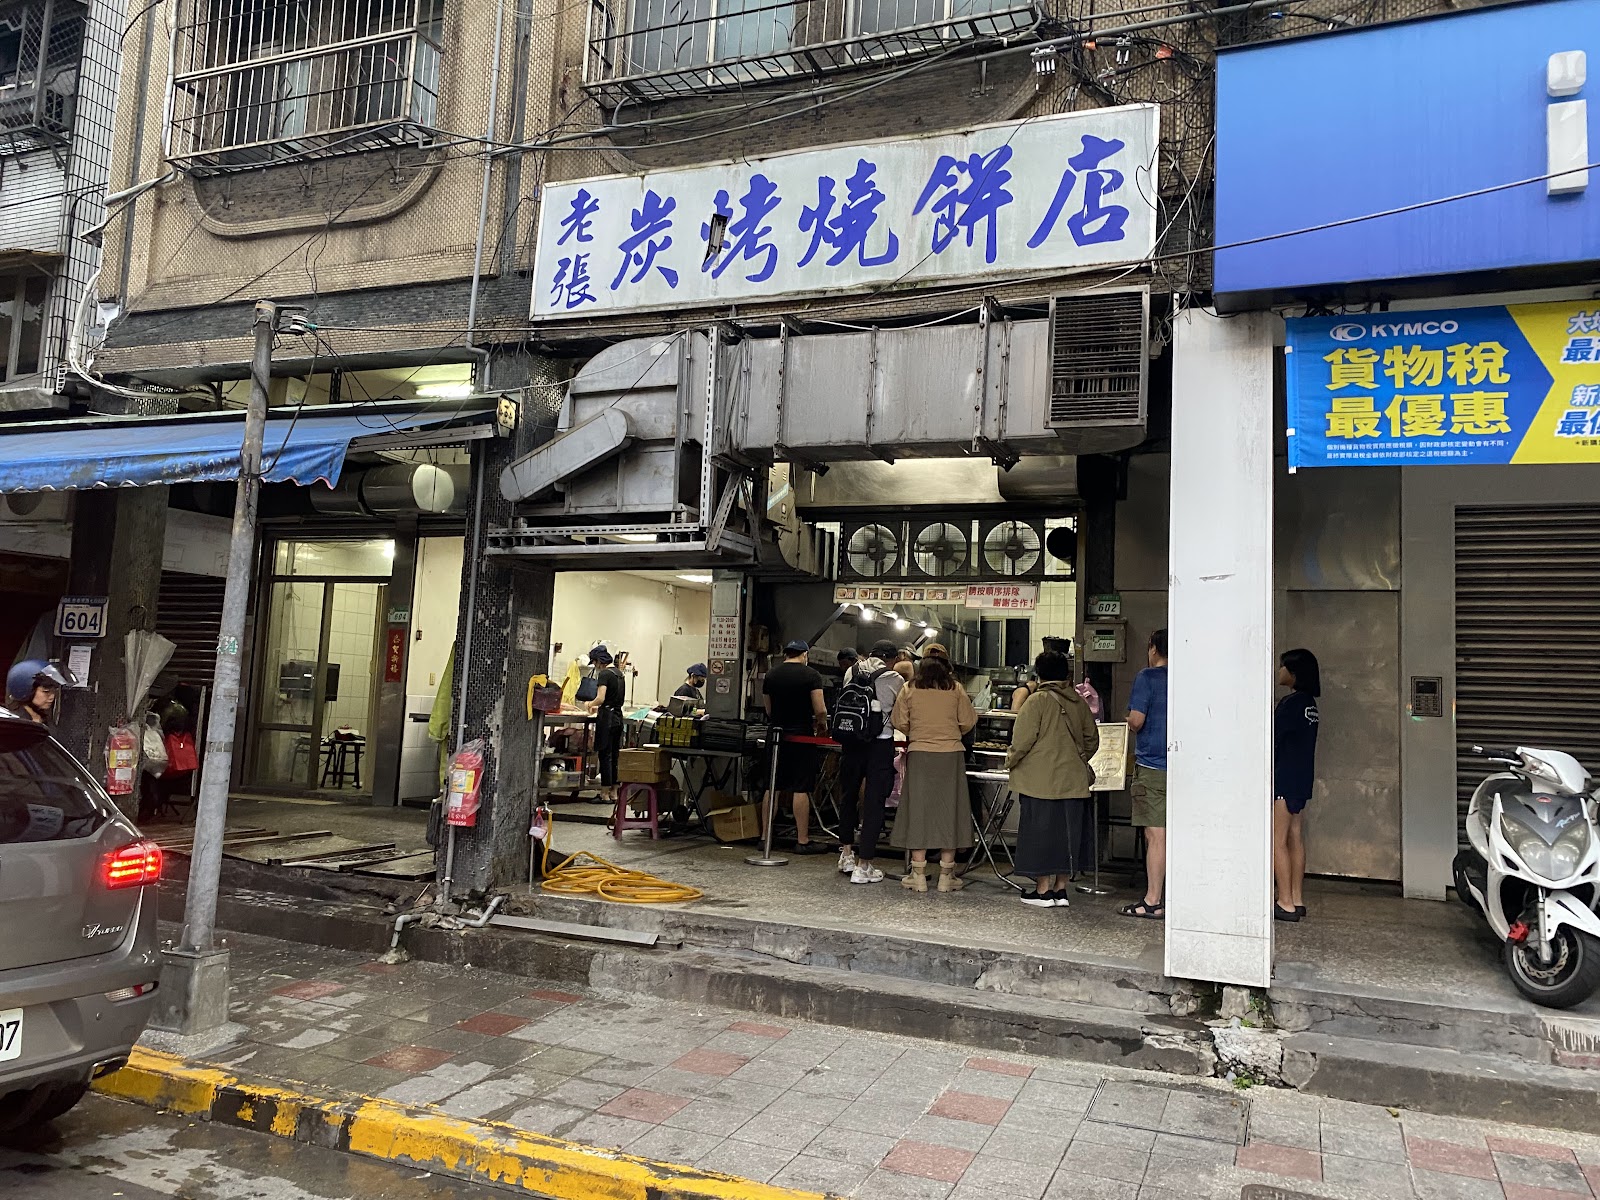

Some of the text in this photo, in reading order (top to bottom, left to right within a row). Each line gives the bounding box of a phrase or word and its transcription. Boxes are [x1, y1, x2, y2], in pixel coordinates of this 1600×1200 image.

[611, 134, 1130, 290] 炭烤燒餅店
[550, 188, 600, 310] 老張
[1371, 320, 1459, 339] KYMCO
[1322, 341, 1511, 391] 貨物稅
[1325, 391, 1512, 439] 最優惠
[968, 586, 1020, 596] 請按順序排隊
[1098, 603, 1117, 613] 602
[64, 611, 98, 631] 604
